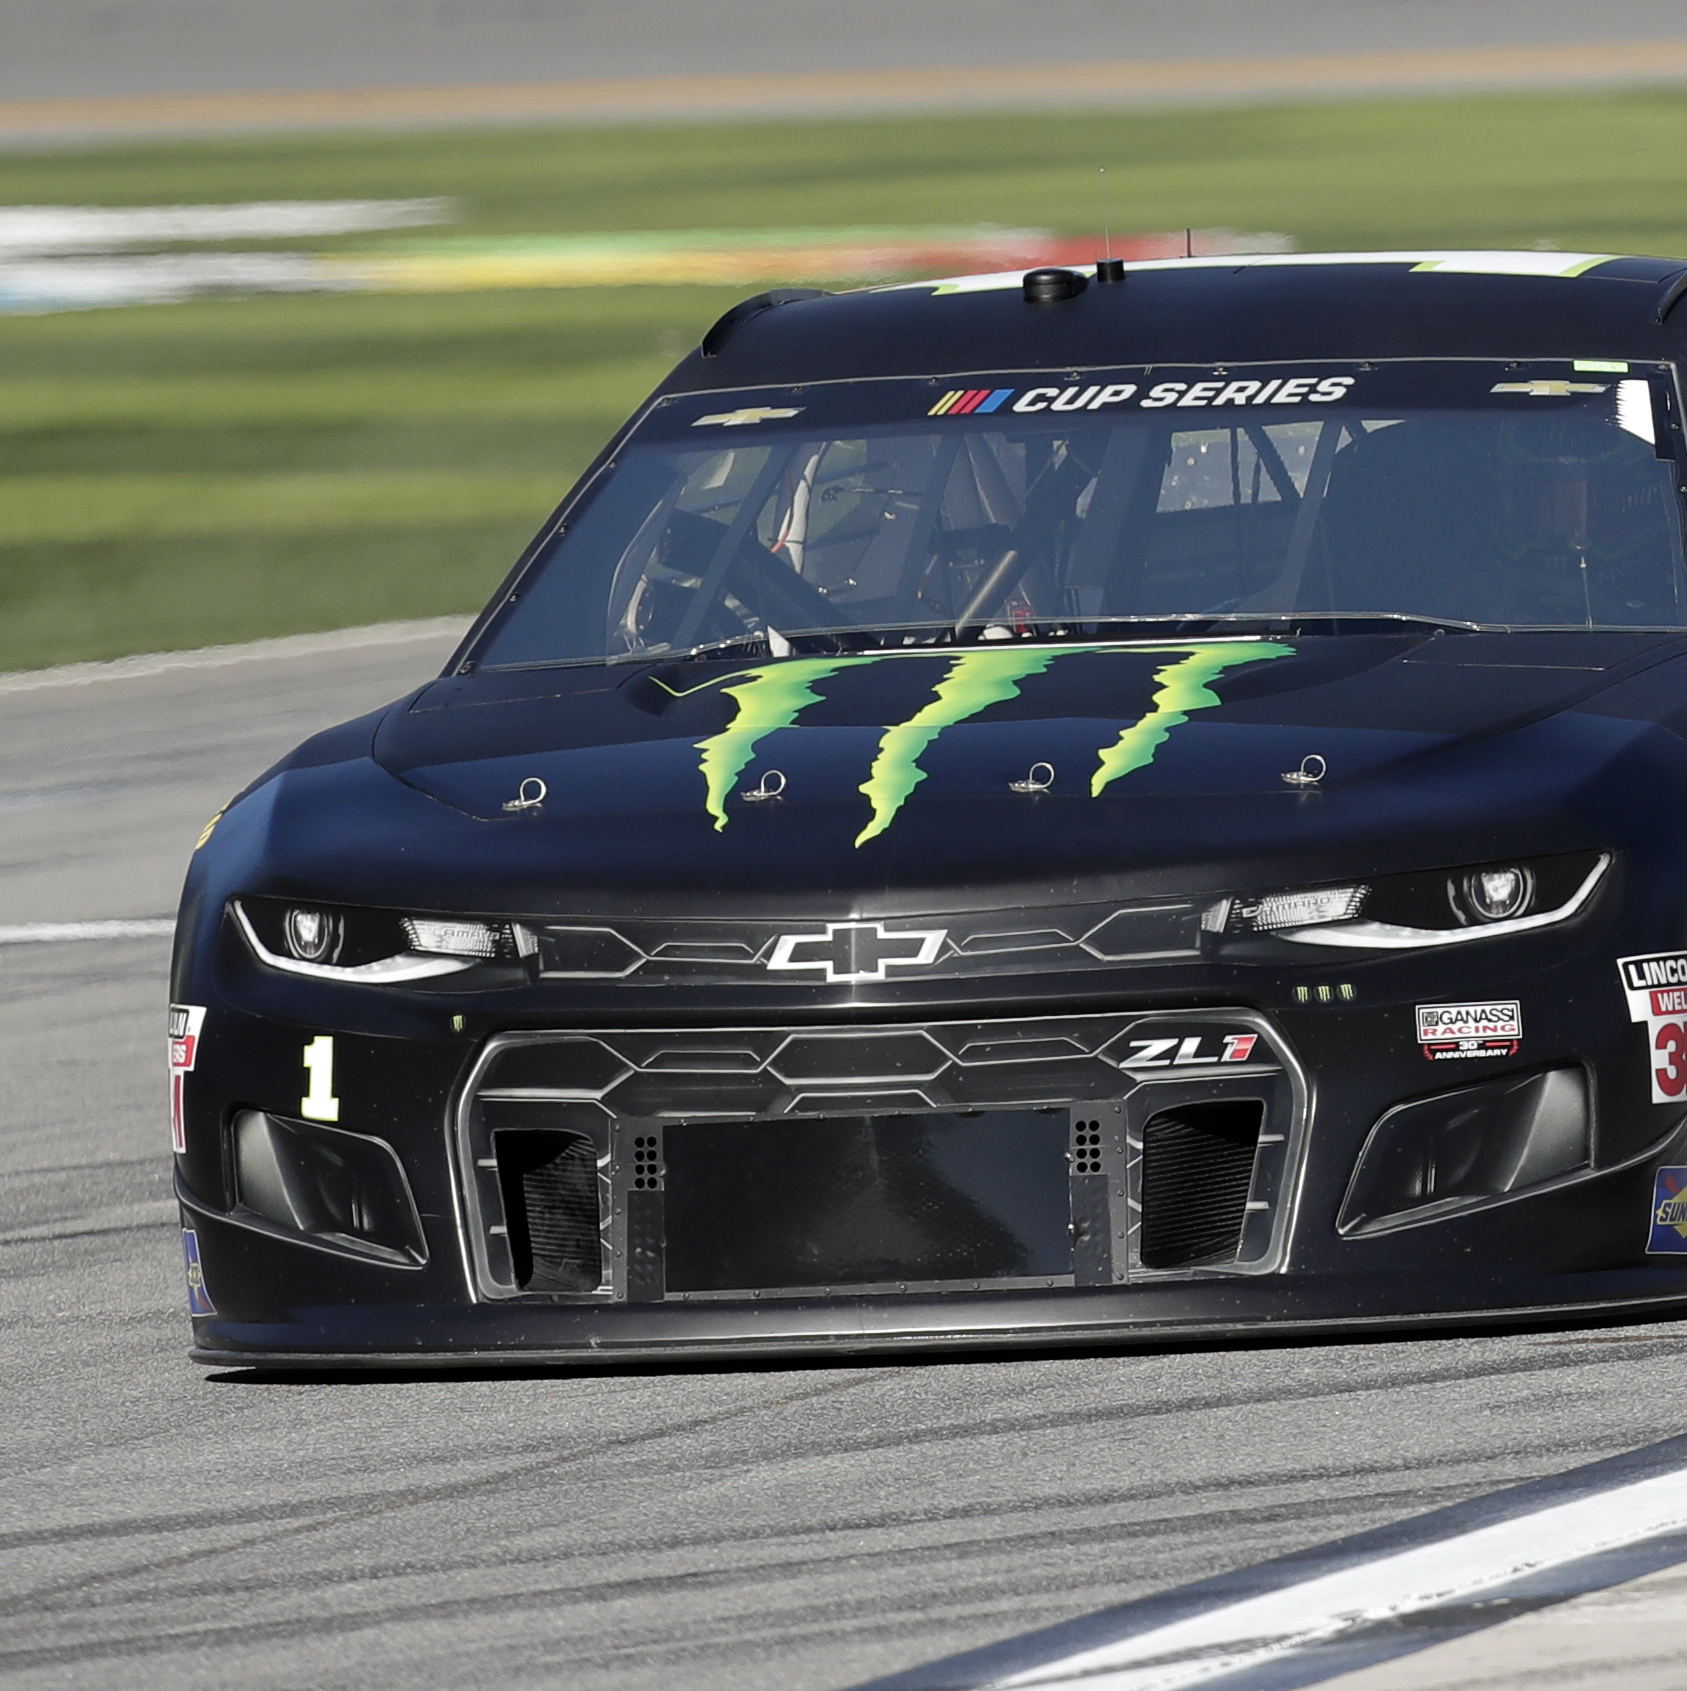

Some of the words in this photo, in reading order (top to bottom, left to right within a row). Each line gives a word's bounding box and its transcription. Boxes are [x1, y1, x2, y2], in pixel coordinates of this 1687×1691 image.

[1012, 383, 1138, 413] CUP
[1139, 376, 1356, 408] SERIES
[1422, 1023, 1516, 1037] RACING
[1440, 1007, 1515, 1026] GANASSI
[1119, 1033, 1258, 1069] ZL1
[1434, 1048, 1508, 1060] ANNIVERSARY
[301, 1035, 340, 1122] 1
